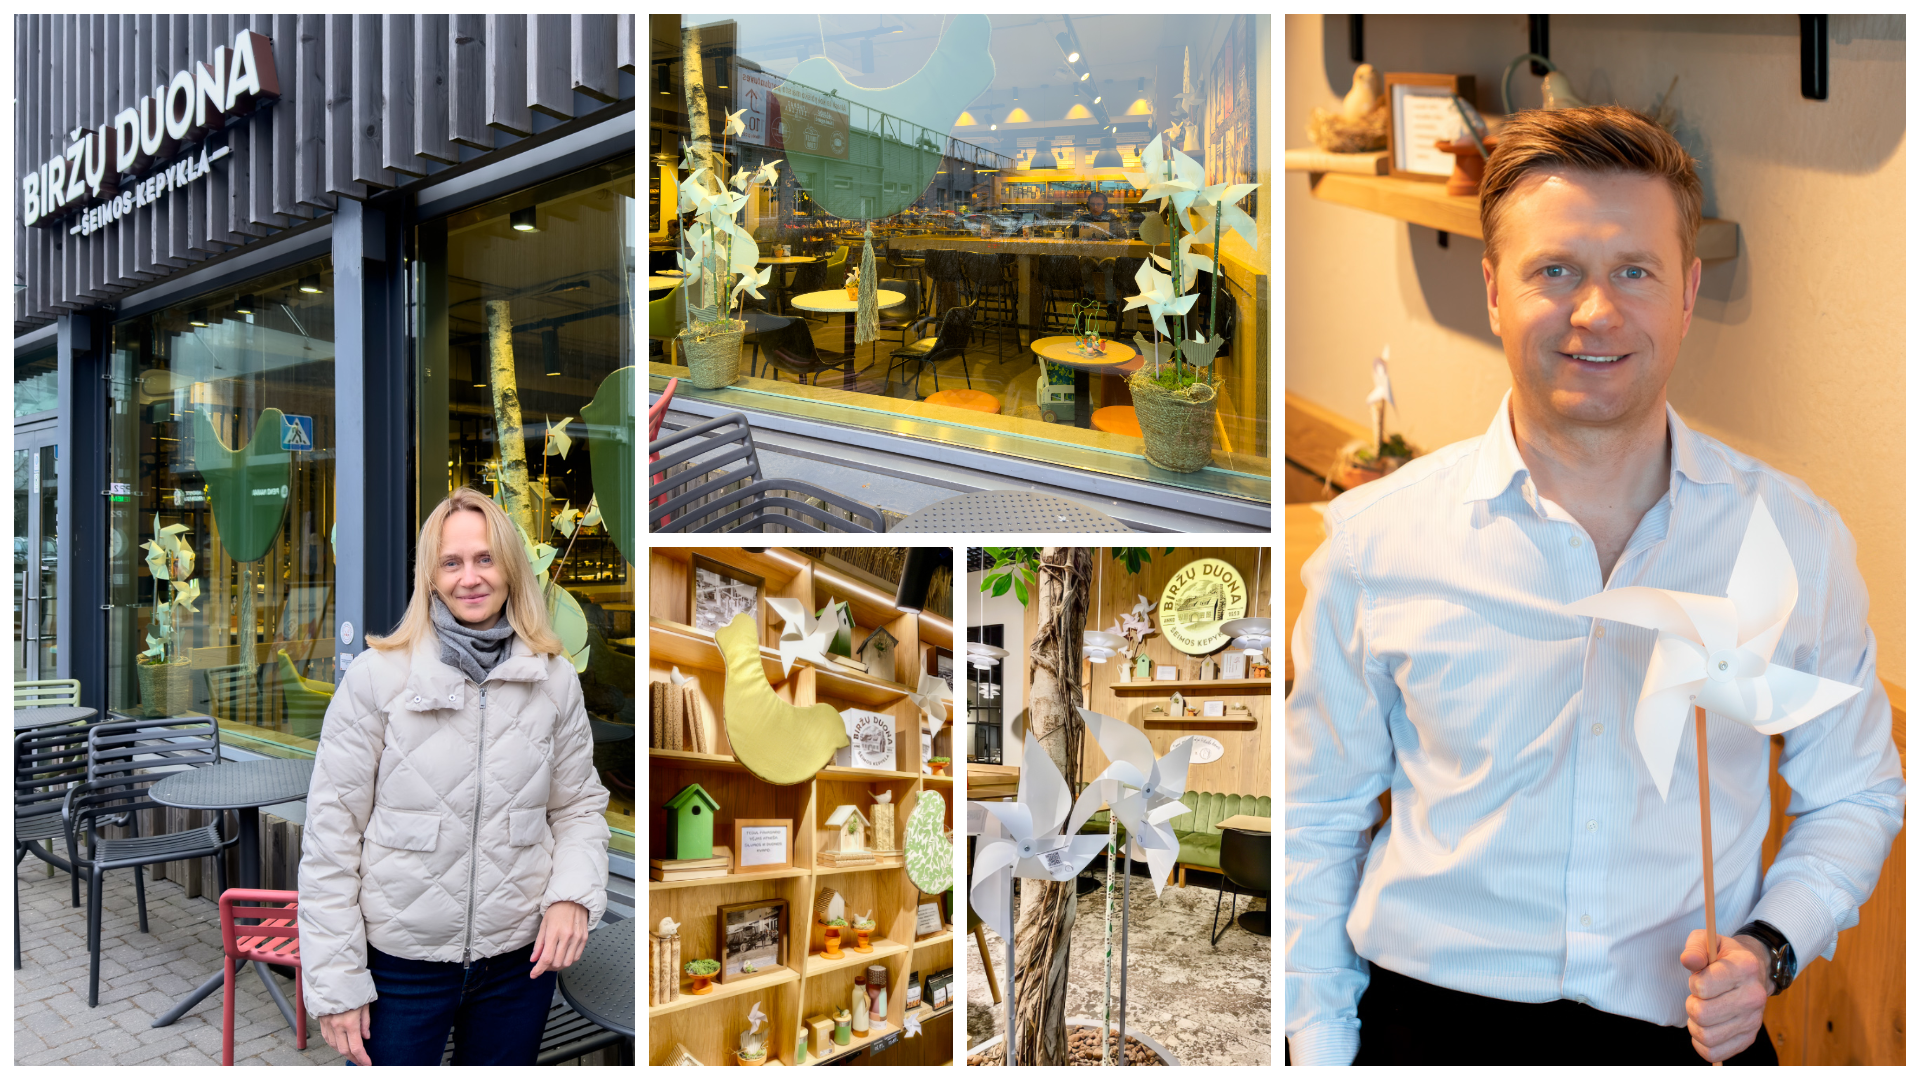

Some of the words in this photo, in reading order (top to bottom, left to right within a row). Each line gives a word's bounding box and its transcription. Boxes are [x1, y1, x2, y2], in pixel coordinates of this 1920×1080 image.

[23, 124, 106, 226] BIRŽŲ
[115, 28, 260, 173] DUONA
[81, 190, 133, 236] ŠEIMOS
[136, 146, 211, 208] KEPYKLA
[1163, 567, 1196, 611] BIRŽŲ
[1203, 564, 1241, 605] DUONA
[1170, 627, 1195, 647] ŠEIMOS
[1197, 632, 1224, 647] KEPYK
[853, 716, 871, 740] BIRŽŲ
[873, 716, 893, 745] DUONA
